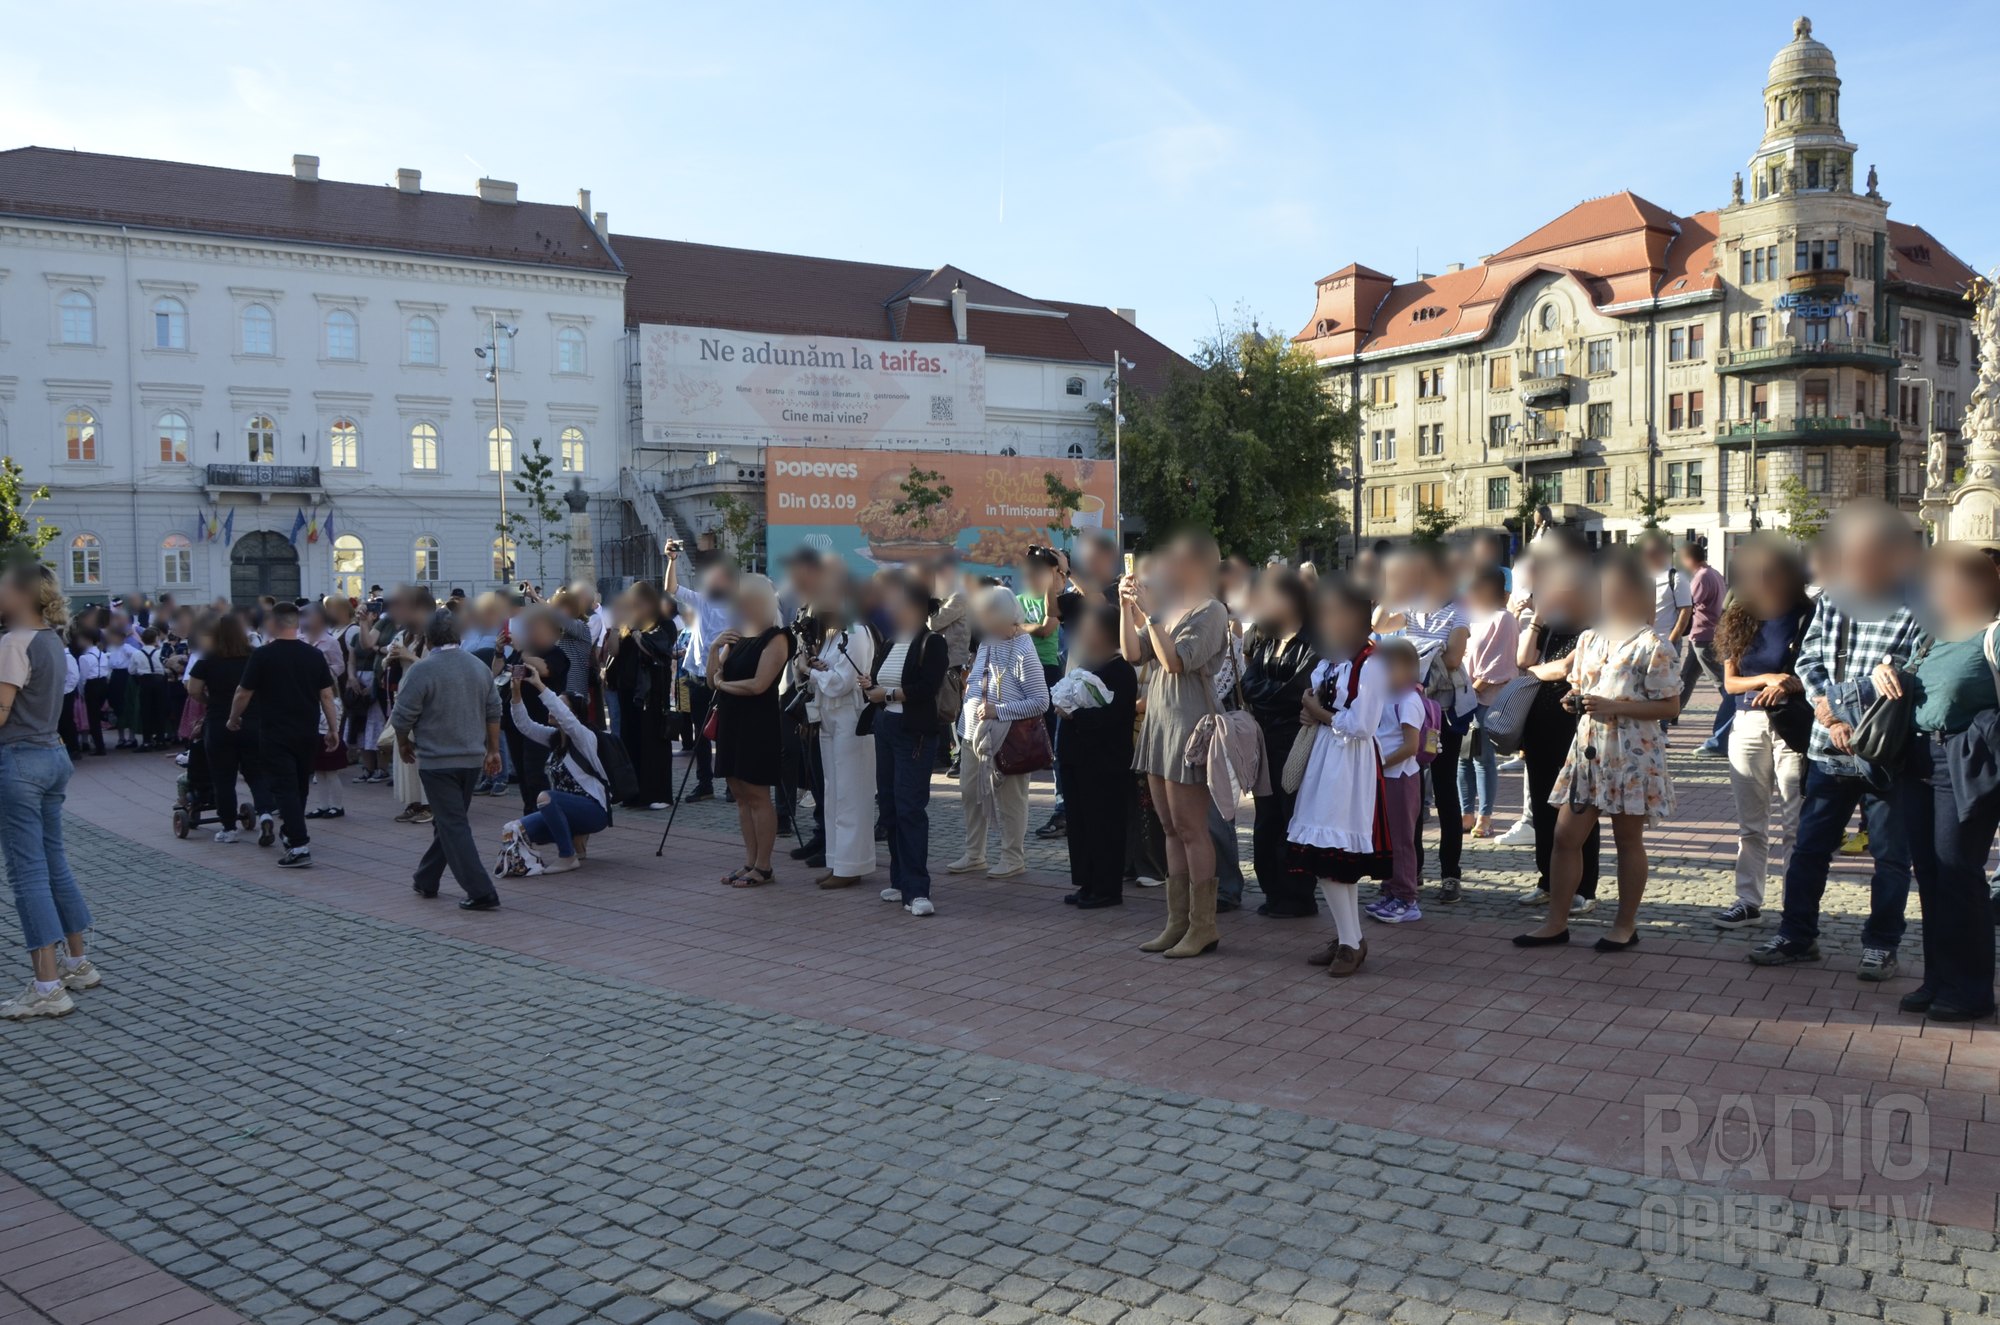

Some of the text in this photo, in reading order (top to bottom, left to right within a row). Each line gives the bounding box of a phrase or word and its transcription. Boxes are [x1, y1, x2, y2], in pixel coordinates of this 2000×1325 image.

[699, 338, 947, 373] Ne adunăm la taifas.
[765, 388, 785, 396] teatru
[797, 389, 820, 397] muzică
[832, 390, 861, 399] literatură
[873, 392, 911, 401] gastronomie
[782, 409, 869, 424] Cine mai vine?
[779, 492, 857, 510] Din 03.09
